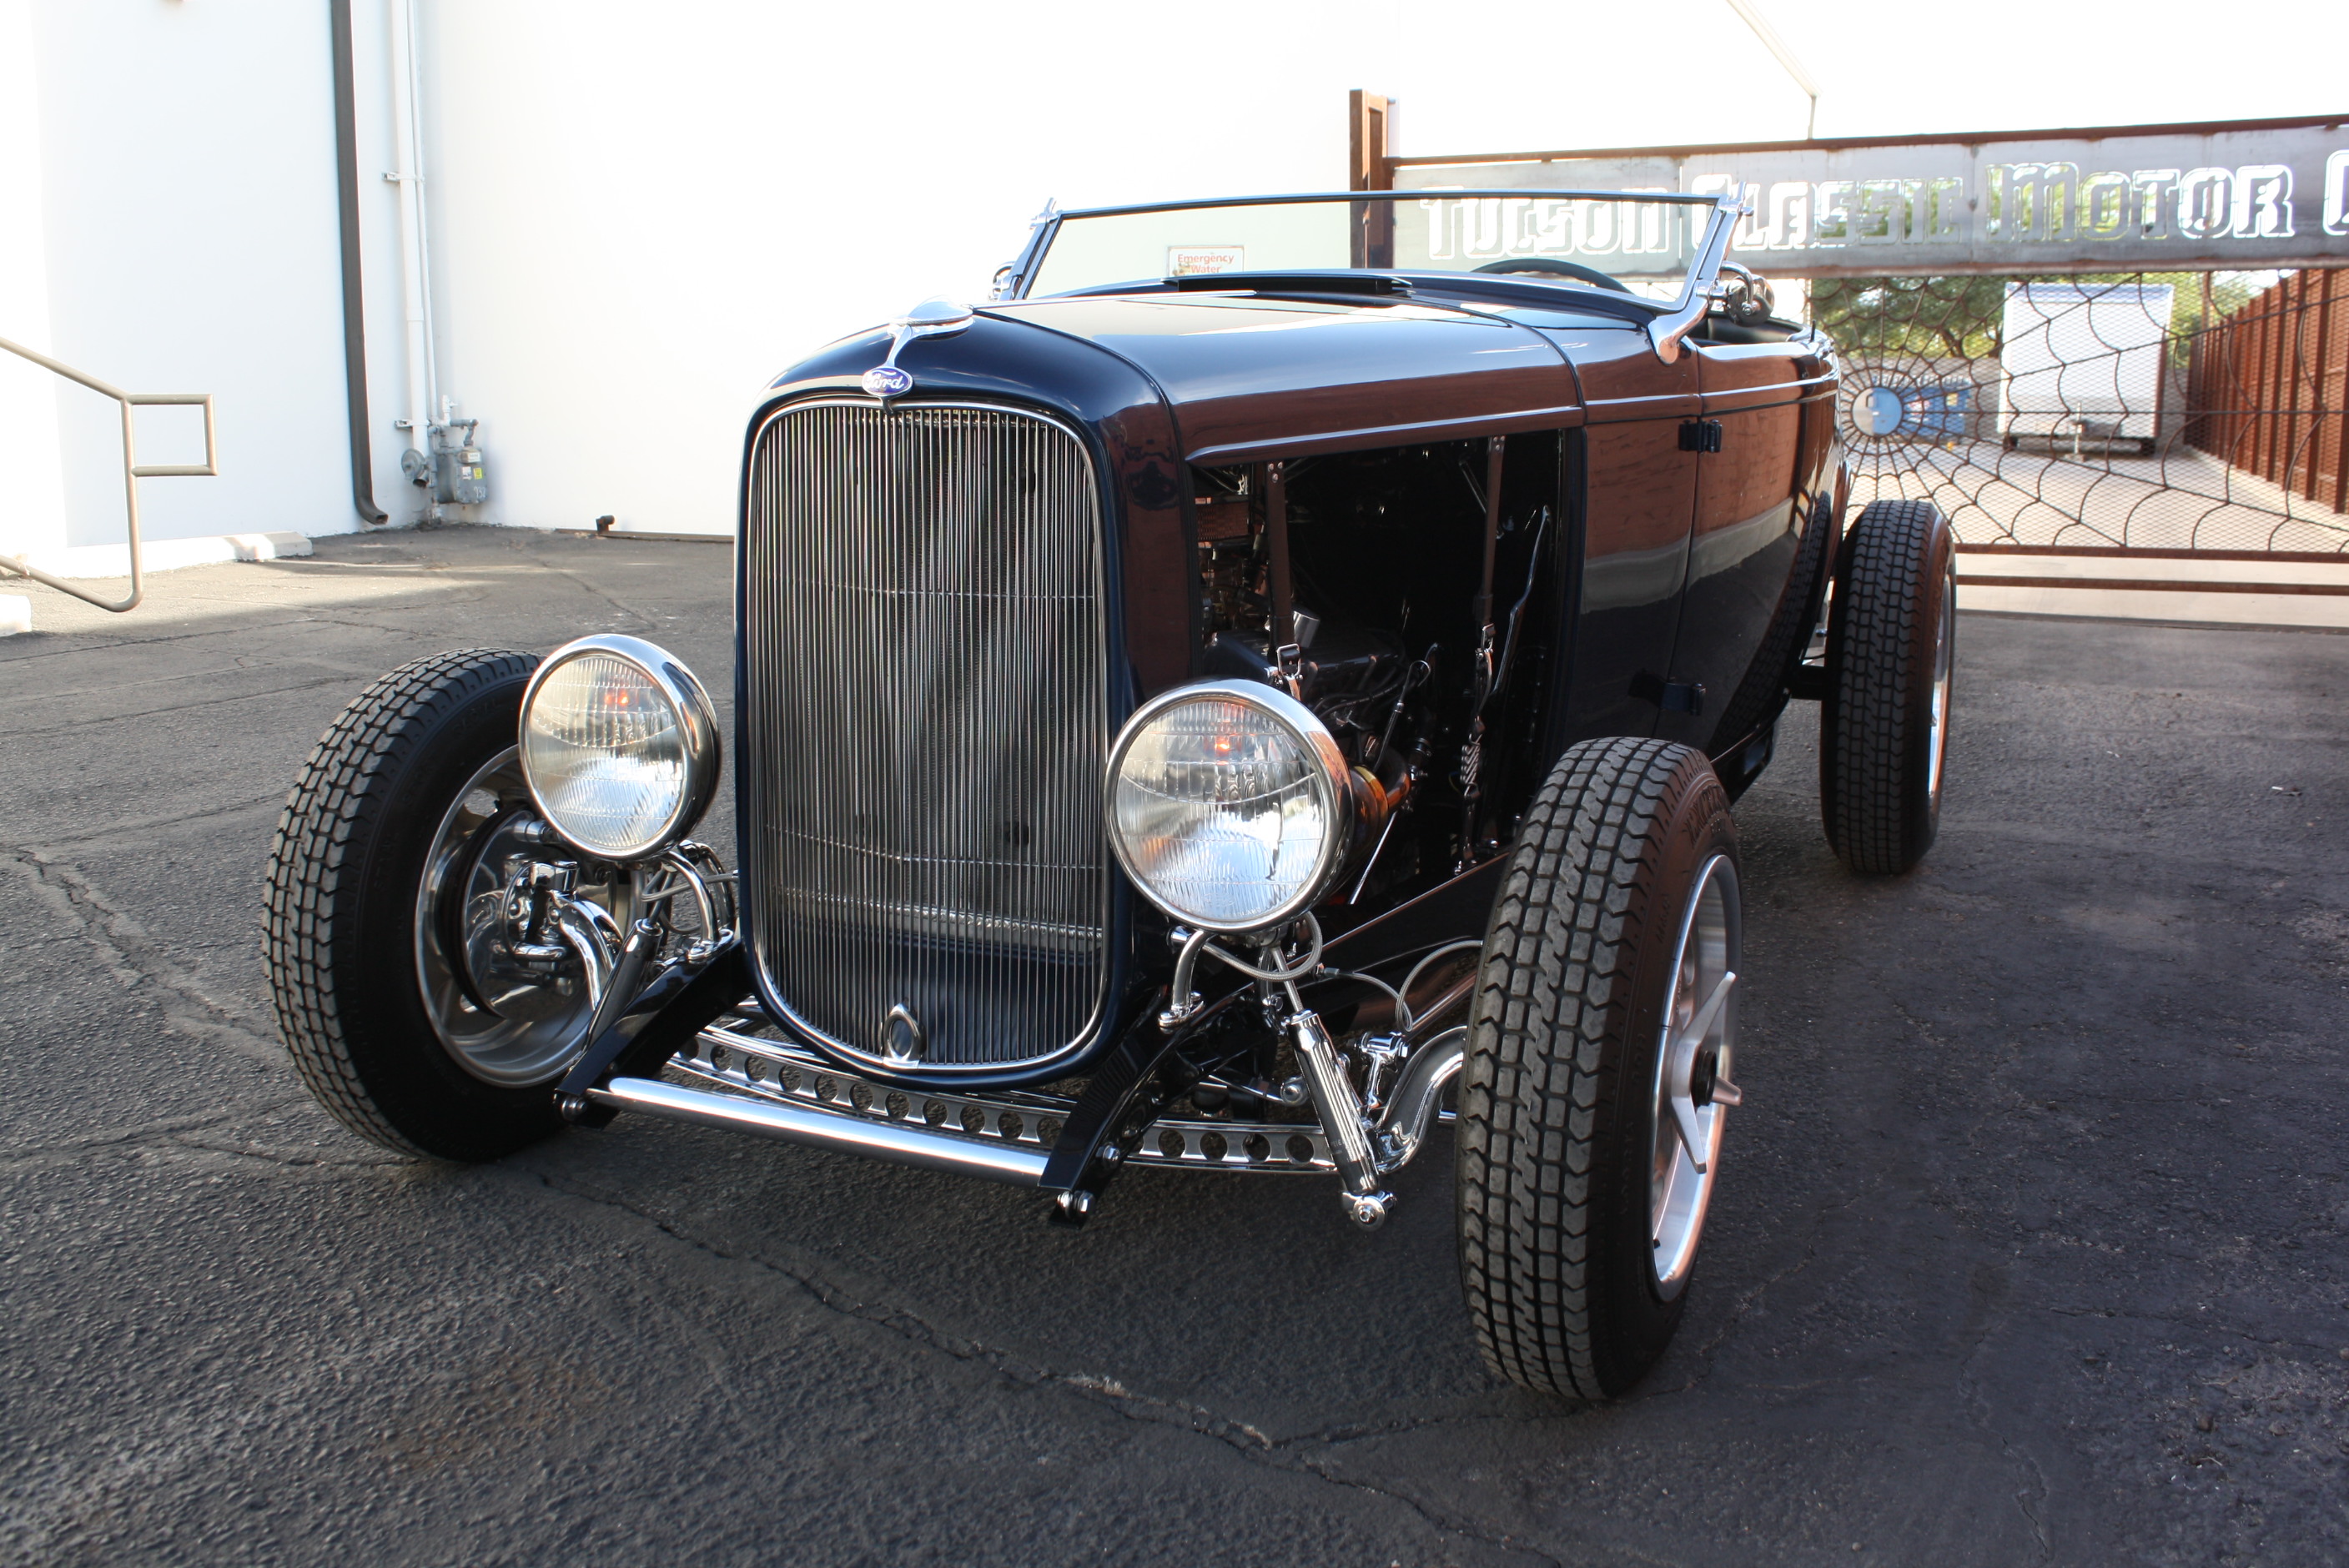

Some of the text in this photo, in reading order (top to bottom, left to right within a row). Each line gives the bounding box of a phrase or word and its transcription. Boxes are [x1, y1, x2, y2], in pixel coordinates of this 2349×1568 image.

[1985, 163, 2296, 243] MOTOR
[1178, 254, 1235, 264] Emergency
[1190, 264, 1221, 274] Water
[866, 369, 904, 389] Ford
